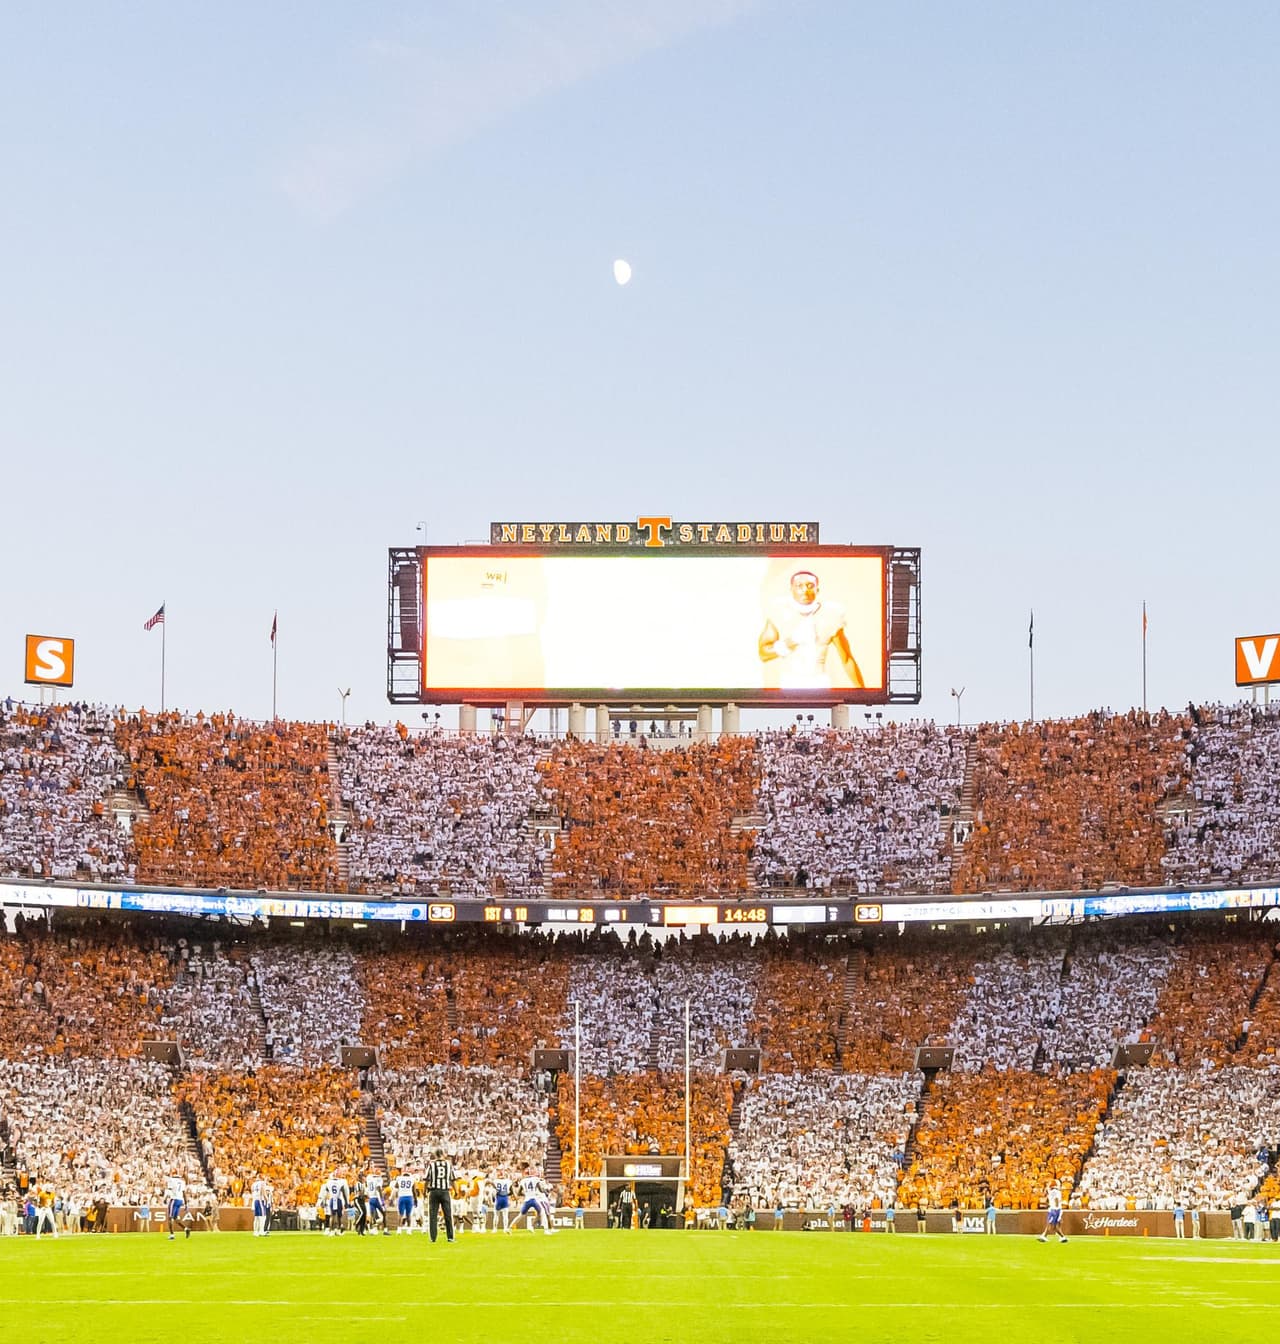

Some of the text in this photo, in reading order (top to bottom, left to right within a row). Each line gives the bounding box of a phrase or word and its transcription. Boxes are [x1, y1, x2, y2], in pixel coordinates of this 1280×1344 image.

[501, 516, 810, 548] NEYLAND T STADIUM
[34, 639, 66, 680] S
[1240, 638, 1280, 680] V
[484, 907, 502, 921] 1ST
[515, 907, 528, 921] 10
[724, 908, 767, 922] 14:48
[436, 1166, 446, 1178] B
[133, 1211, 207, 1222] NISAN
[811, 1219, 846, 1230] plaet
